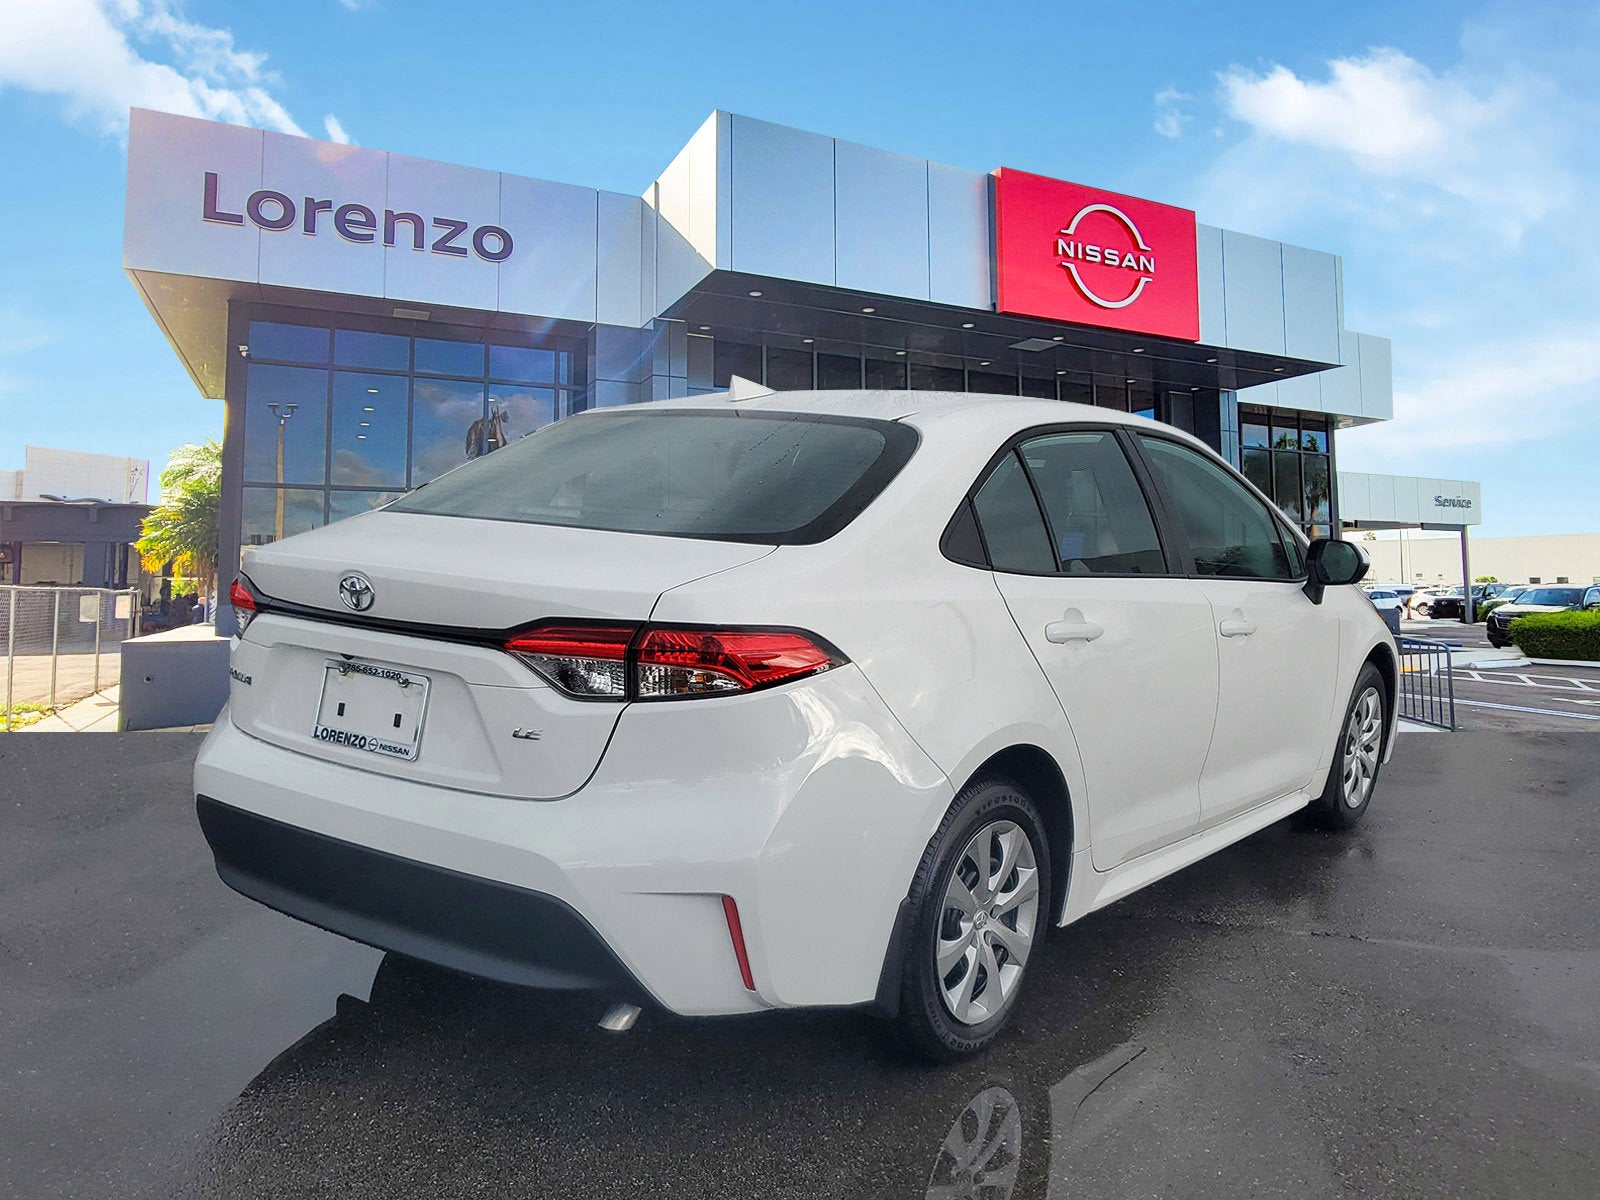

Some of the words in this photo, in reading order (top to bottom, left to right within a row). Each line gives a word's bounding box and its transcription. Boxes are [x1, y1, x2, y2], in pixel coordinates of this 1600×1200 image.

[203, 171, 514, 262] Lorenzo
[1057, 238, 1155, 273] NISSAN
[1434, 495, 1472, 509] Service
[313, 725, 367, 750] LORENZO
[379, 743, 410, 756] NISSAN
